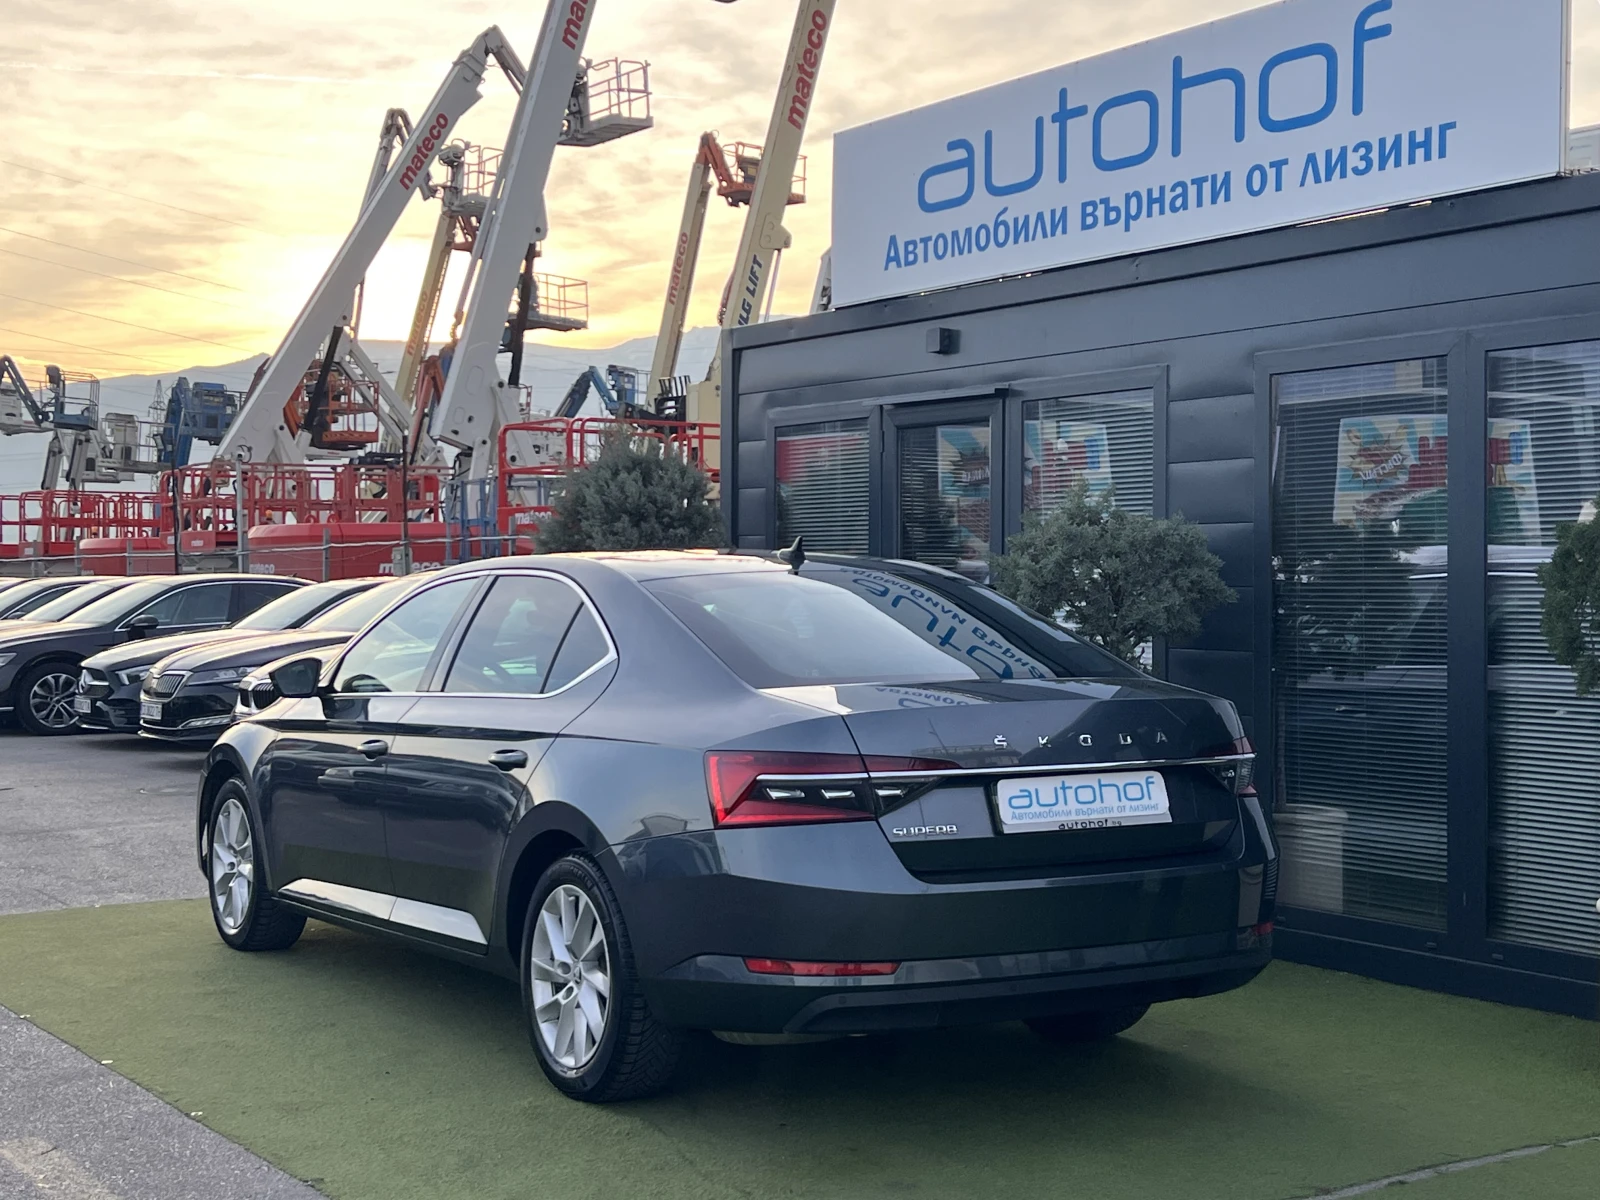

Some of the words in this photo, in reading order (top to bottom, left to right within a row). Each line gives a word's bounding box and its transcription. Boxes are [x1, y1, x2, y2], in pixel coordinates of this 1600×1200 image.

[562, 0, 588, 50] ma
[788, 9, 827, 131] mateco
[917, 0, 1392, 213] autohof
[399, 113, 449, 191] mateco
[884, 206, 1069, 272] Автомобили
[1081, 171, 1232, 231] върнати
[1245, 158, 1290, 194] от
[1299, 121, 1457, 188] лизинг
[669, 232, 688, 306] mateco
[746, 254, 762, 298] LIFT
[378, 562, 440, 574] meco
[1008, 775, 1156, 810] autohof
[1011, 807, 1072, 821] Автомобили
[1075, 805, 1115, 817] върнати
[1117, 804, 1127, 813] от
[1129, 802, 1160, 812] лизинг
[892, 824, 958, 837] SUPERB
